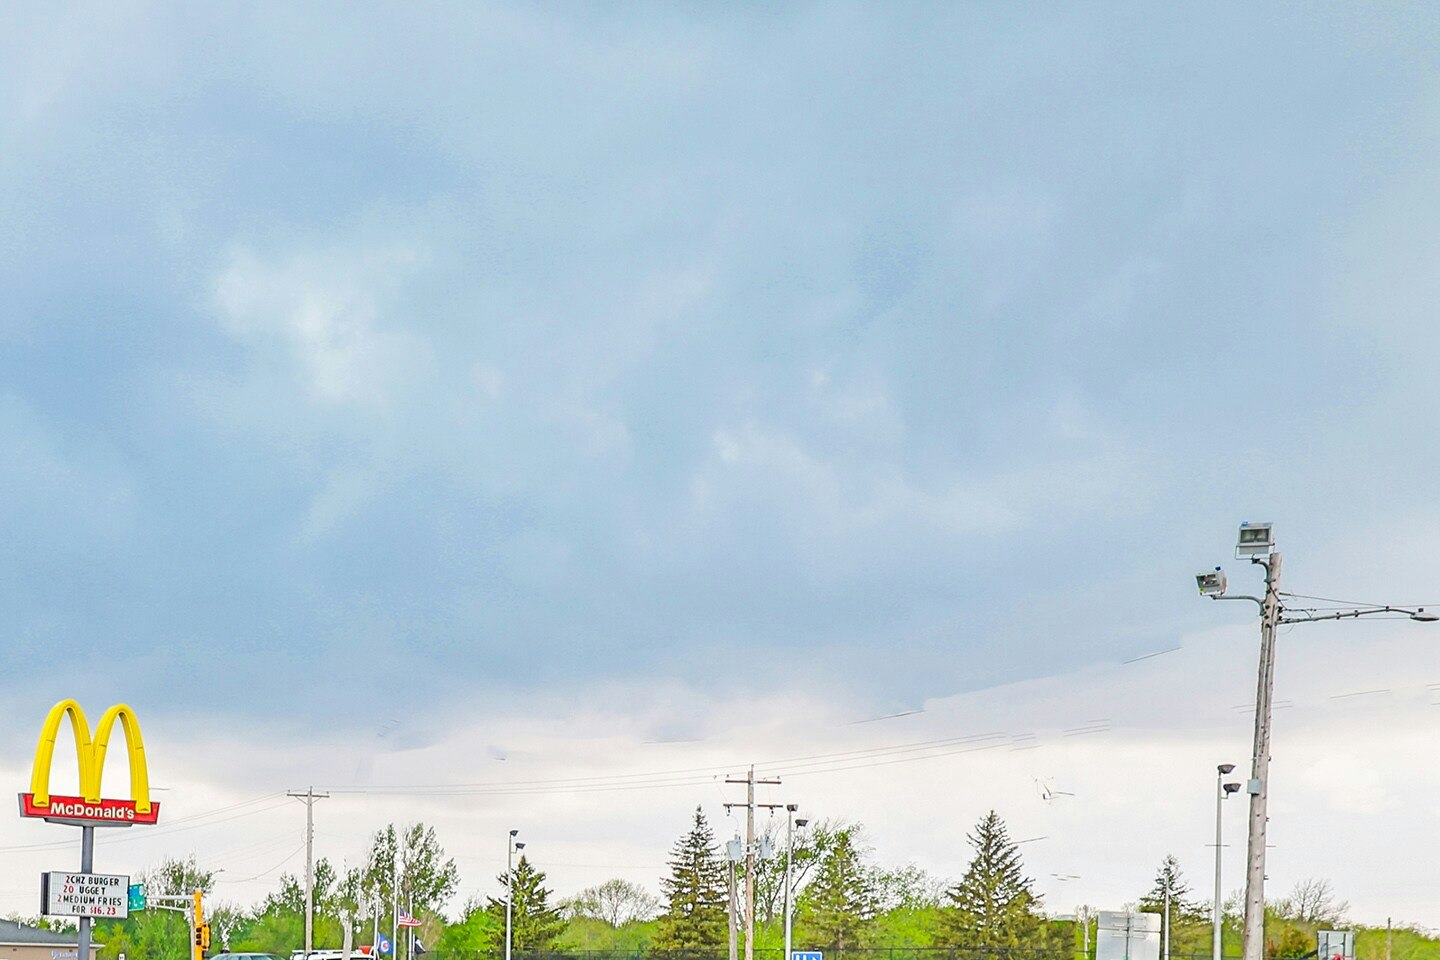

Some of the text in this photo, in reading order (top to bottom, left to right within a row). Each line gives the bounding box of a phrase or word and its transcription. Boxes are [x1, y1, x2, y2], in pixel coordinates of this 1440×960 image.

[50, 802, 135, 819] McDonald's
[88, 876, 120, 886] BURGER
[63, 885, 74, 893] 20
[63, 896, 95, 905] MEDIUM
[97, 897, 122, 906] FRIES
[72, 905, 86, 914] FOR
